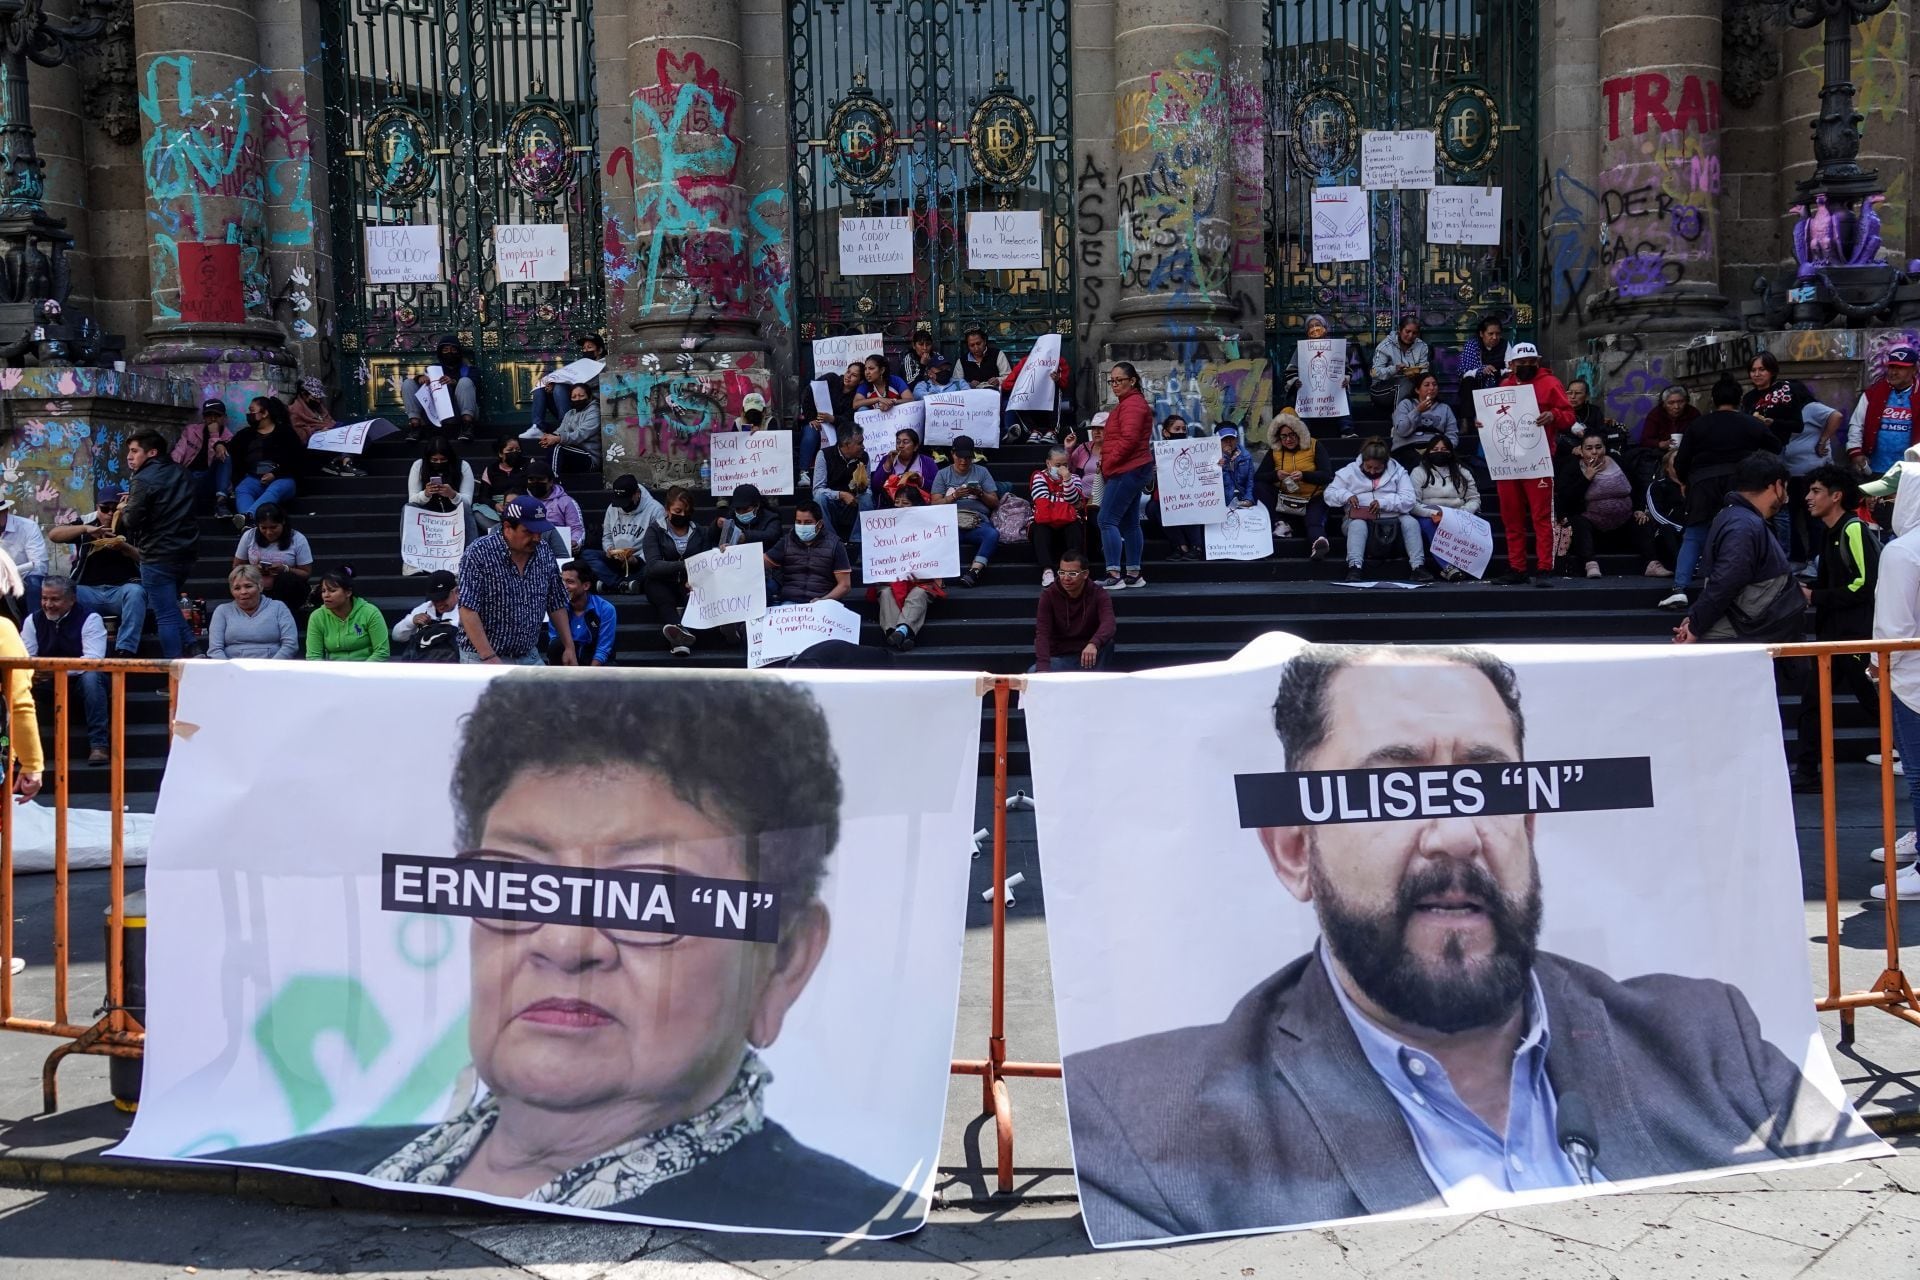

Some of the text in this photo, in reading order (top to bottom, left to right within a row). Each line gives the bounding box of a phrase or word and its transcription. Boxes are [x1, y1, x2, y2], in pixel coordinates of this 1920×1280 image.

[1470, 192, 1479, 204] la
[1432, 206, 1465, 218] Fiscal
[842, 220, 856, 232] NO
[859, 219, 866, 231] A
[872, 218, 884, 231] LA
[994, 214, 1016, 232] NO
[1431, 221, 1442, 230] NO
[368, 230, 411, 248] FUERA
[496, 227, 536, 244] GODOY
[862, 232, 890, 242] GODOY
[388, 248, 431, 262] GODOY
[500, 245, 557, 264] Empleada de
[842, 244, 854, 253] NO
[504, 260, 539, 280] la 4T
[1517, 346, 1535, 354] FILA
[712, 435, 778, 450] Fiscal carnal
[750, 452, 762, 463] 4T
[612, 524, 645, 538] BOSTON
[934, 524, 950, 537] 4T
[710, 552, 742, 571] Godoy
[768, 604, 814, 614] Ernestina
[1298, 764, 1584, 822] ULISES “N”
[394, 864, 774, 930] ERNESTINA “N”
